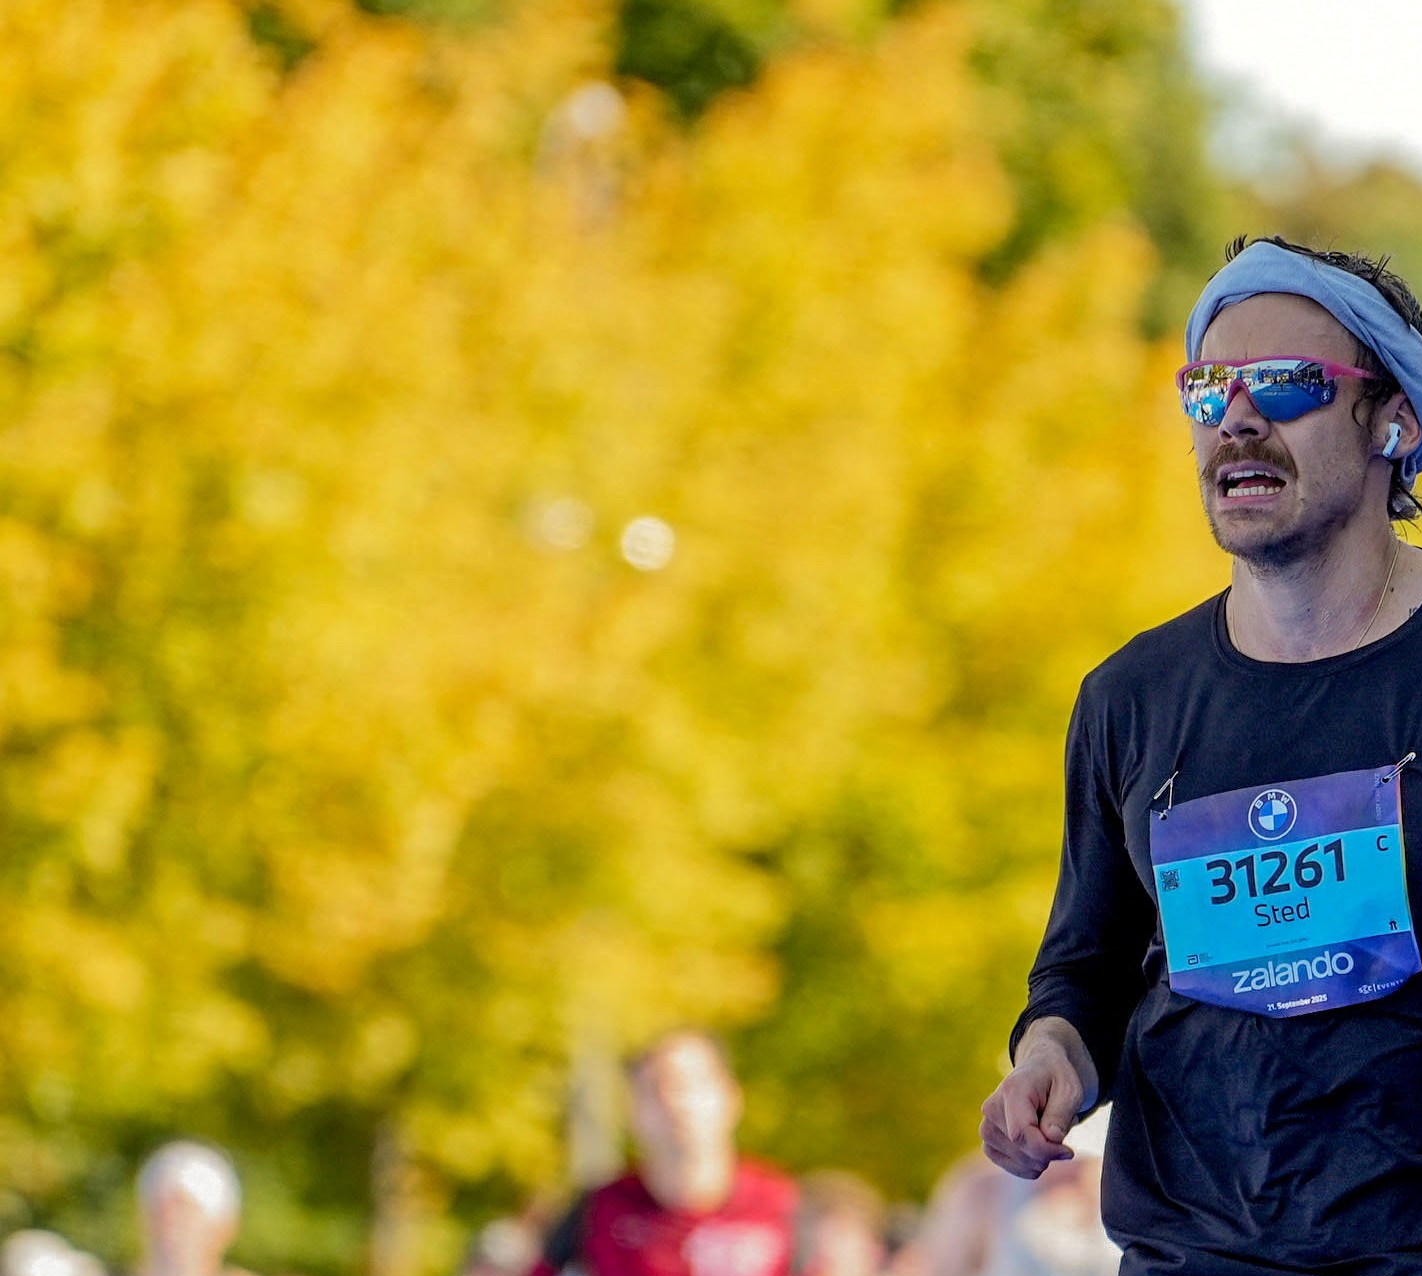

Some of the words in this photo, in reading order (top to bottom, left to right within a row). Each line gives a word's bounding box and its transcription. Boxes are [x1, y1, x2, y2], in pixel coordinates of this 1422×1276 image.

[1254, 792, 1291, 810] BMW
[1376, 834, 1390, 852] C
[1205, 837, 1346, 906] 31261
[1254, 896, 1311, 928] Sted
[1231, 950, 1354, 994] zalando
[1276, 997, 1311, 1010] September
[1310, 993, 1328, 1005] 2025
